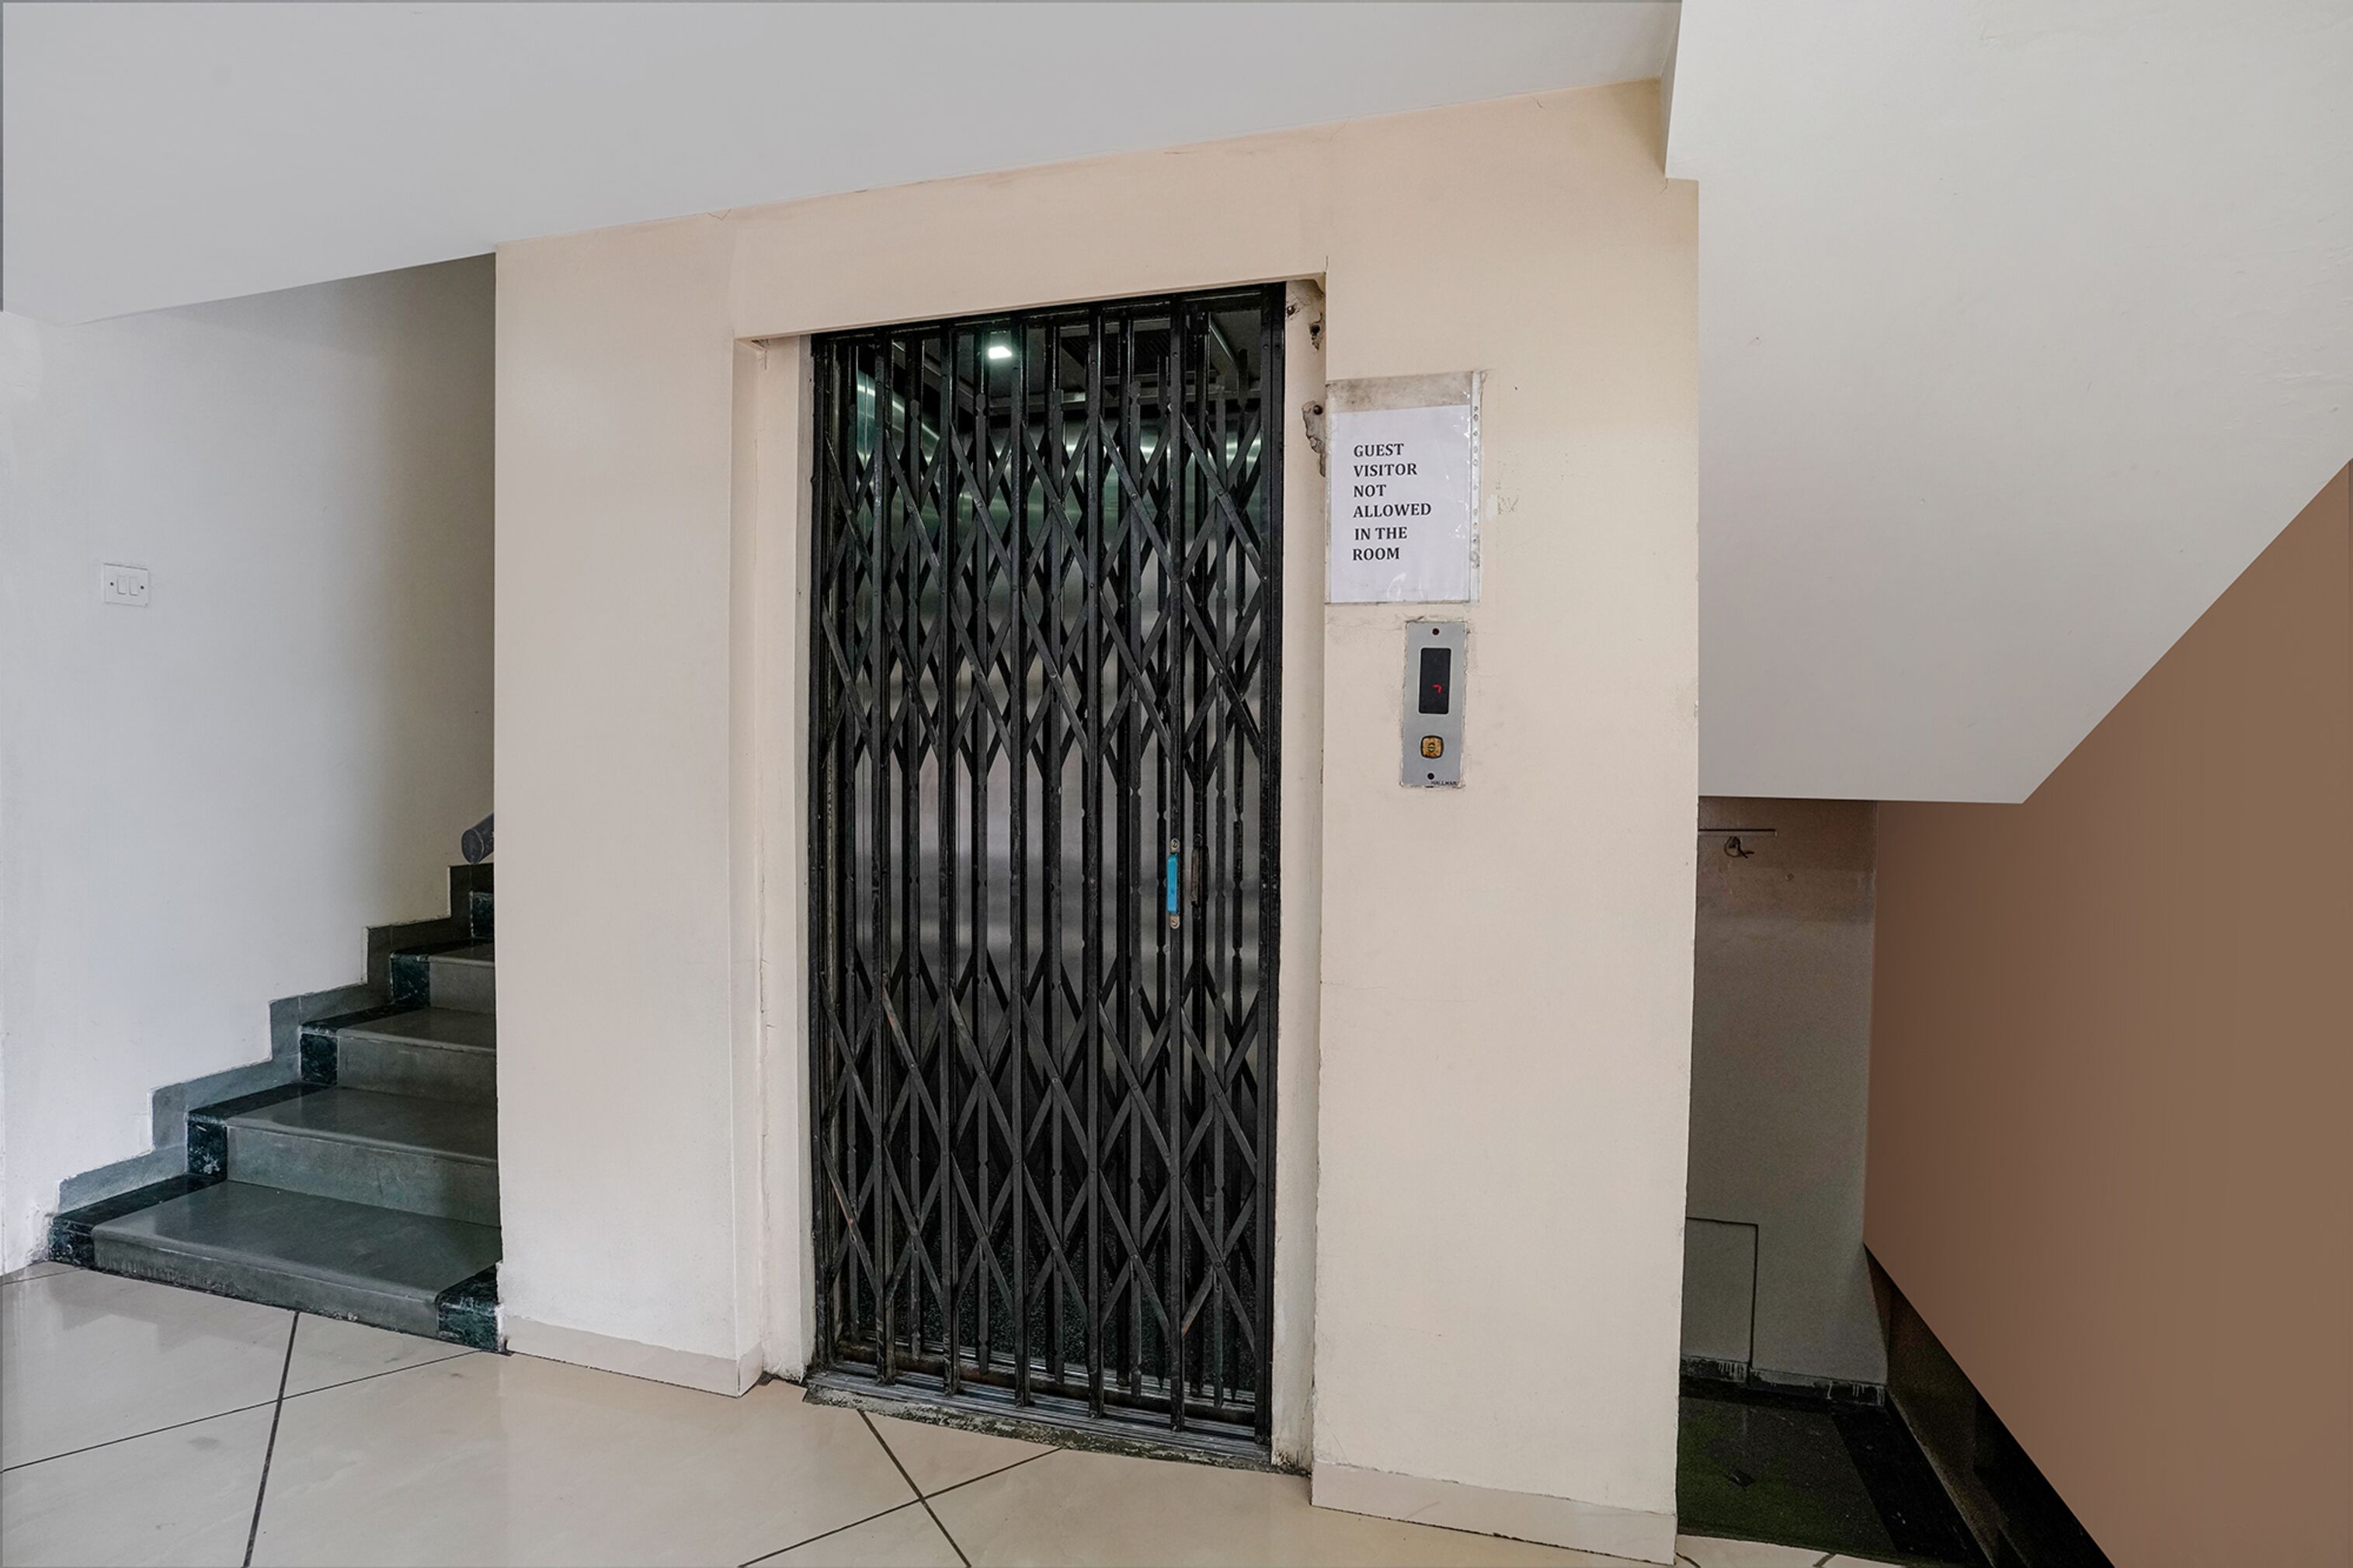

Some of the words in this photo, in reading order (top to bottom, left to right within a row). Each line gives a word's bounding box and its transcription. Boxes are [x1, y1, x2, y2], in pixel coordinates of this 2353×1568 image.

[1354, 443, 1404, 457] GUEST
[1354, 463, 1417, 477] VISITOR
[1354, 485, 1386, 498] NOT
[1353, 503, 1431, 518] ALLOWED
[1354, 528, 1371, 541] IN
[1375, 527, 1407, 540] THE
[1353, 548, 1399, 561] ROOM
